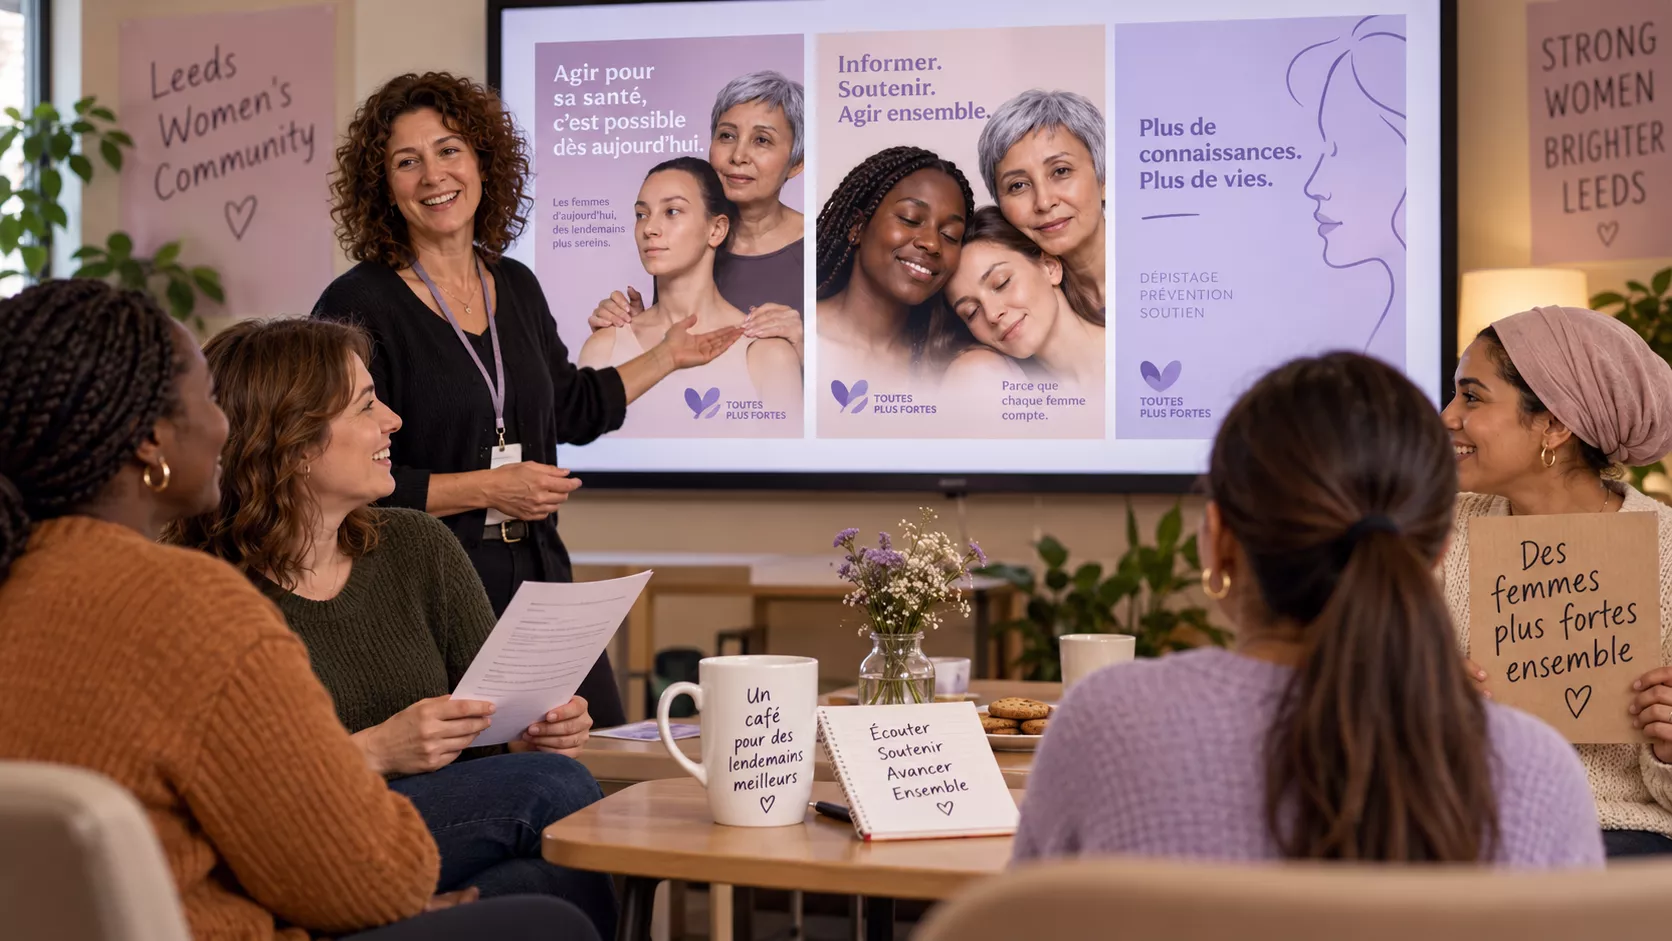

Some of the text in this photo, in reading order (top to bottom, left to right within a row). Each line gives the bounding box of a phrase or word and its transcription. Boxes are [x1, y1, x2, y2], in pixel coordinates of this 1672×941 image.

[1541, 20, 1658, 73] STRONG
[150, 44, 238, 100] Leeds
[837, 53, 943, 74] Informer.
[553, 63, 655, 86] Agir pour
[553, 87, 648, 107] sa santé,
[837, 77, 937, 99] Soutenir.
[1544, 69, 1655, 119] WOMEN
[158, 75, 293, 148] Women's
[553, 110, 687, 134] c'est possible
[837, 101, 993, 128] Agir ensemble.
[1139, 116, 1217, 138] Plus de
[553, 134, 704, 159] dès aujourd'hui.
[1138, 143, 1303, 164] connaissances.
[1544, 119, 1666, 170] BRIGHTER
[154, 122, 317, 201] Community
[1139, 168, 1274, 190] Plus de vies.
[553, 197, 610, 207] Les femmes
[1562, 170, 1648, 214] LEEDS
[552, 210, 617, 222] d'aujourd'hui,
[552, 223, 626, 235] des lendemains
[552, 237, 612, 250] plus sereins.
[1140, 270, 1219, 284] DÉPISTAGE
[1139, 288, 1234, 302] PRÉVENTION
[1139, 307, 1205, 319] SOUTIEN
[1001, 380, 1059, 393] Parce que
[726, 400, 764, 410] TOUTES
[873, 394, 913, 403] TOUTES
[1001, 395, 1087, 408] chaque femme
[1139, 396, 1184, 407] TOUTES
[725, 411, 787, 420] PLUS FORTES
[873, 405, 938, 414] PLUS FORTES
[1001, 411, 1049, 423] compte.
[1139, 408, 1212, 419] PLUS FORTES
[1520, 540, 1567, 571] Des
[1491, 570, 1600, 614] femmes
[1495, 600, 1638, 656] plus fortes
[1506, 635, 1634, 683] ensemble
[747, 687, 771, 704] Un
[744, 707, 781, 728] café
[869, 723, 931, 741] Écouter
[734, 732, 794, 755] pour des
[877, 741, 944, 761] Soutenir
[728, 750, 804, 772] lendemains
[886, 762, 953, 781] Avancer
[733, 771, 798, 792] meilleurs
[892, 779, 970, 801] Ensemble
